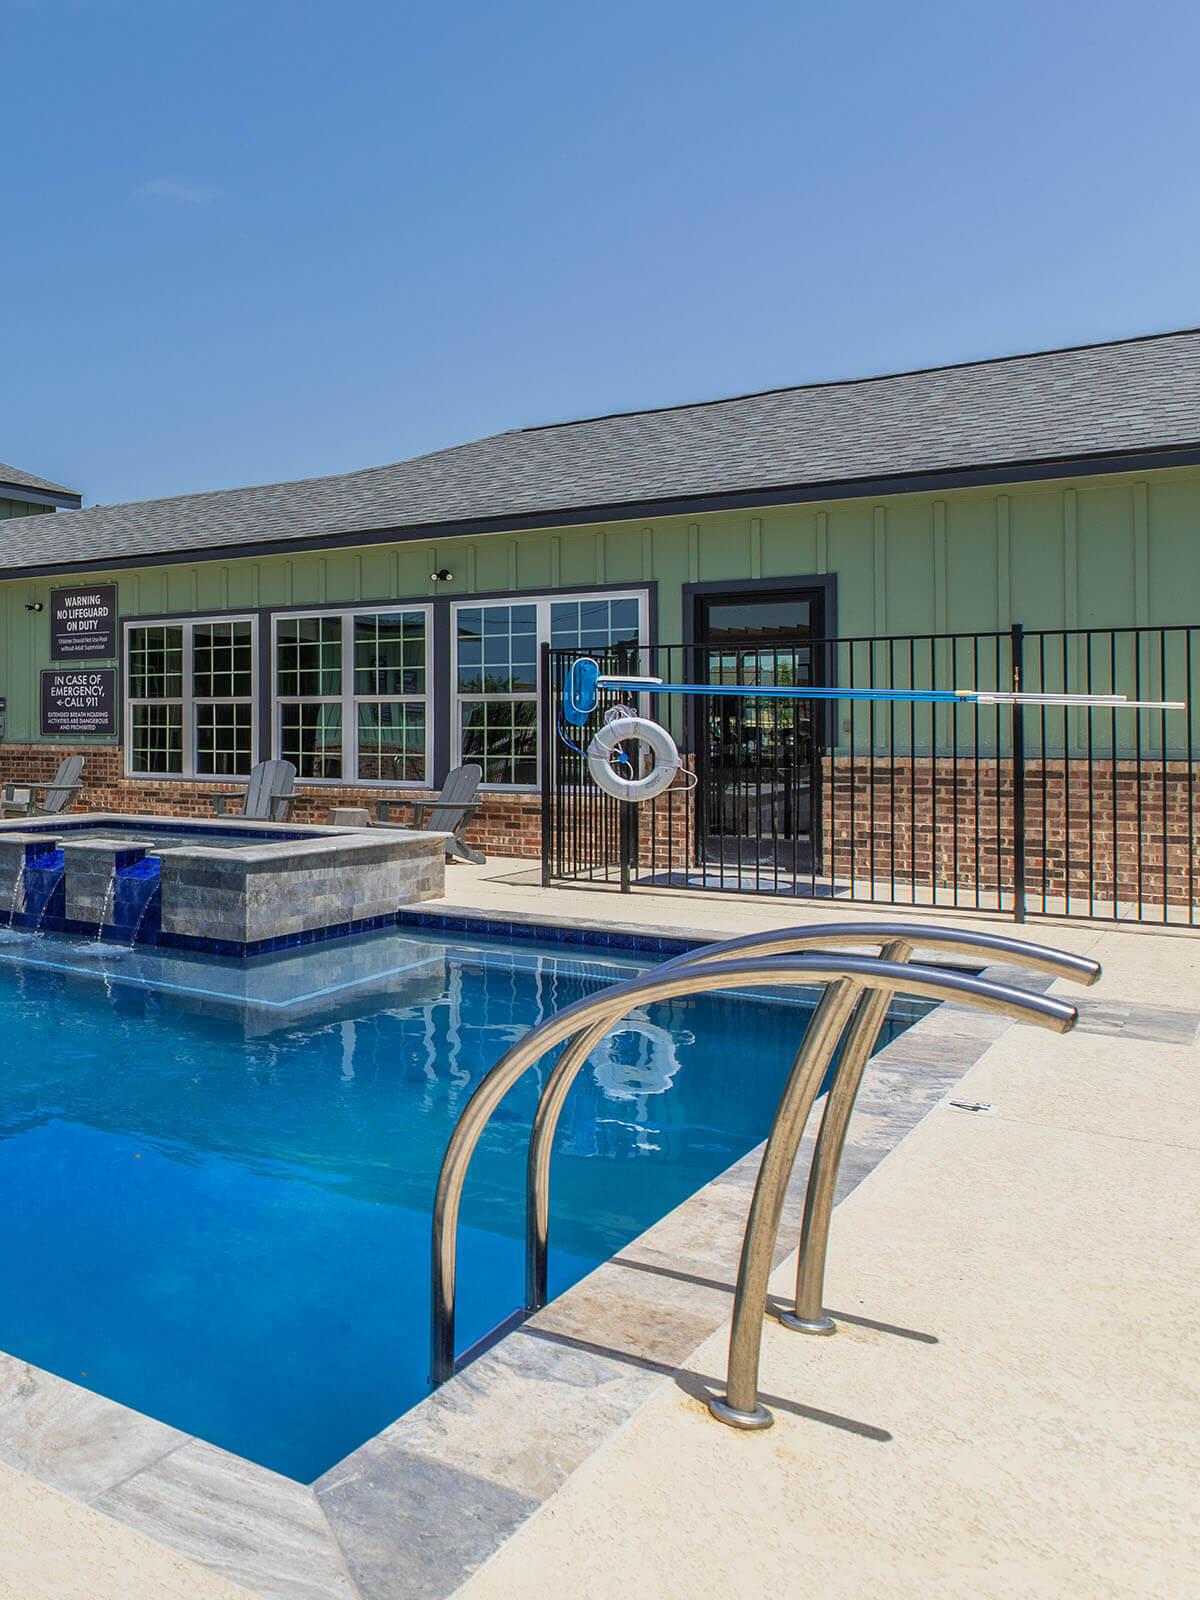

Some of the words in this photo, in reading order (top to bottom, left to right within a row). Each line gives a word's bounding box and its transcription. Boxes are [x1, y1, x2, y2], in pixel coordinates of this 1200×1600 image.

[65, 595, 100, 607] WARNING
[57, 610, 67, 619] NO
[69, 607, 108, 618] LIFEGUARD
[67, 622, 77, 631] ON
[79, 620, 98, 630] DUTY
[55, 676, 64, 685] IN
[66, 675, 87, 685] CASE
[89, 675, 101, 684] OF
[51, 686, 104, 696] EMERGENCY,
[65, 697, 84, 706] CALL
[86, 697, 98, 706] 911
